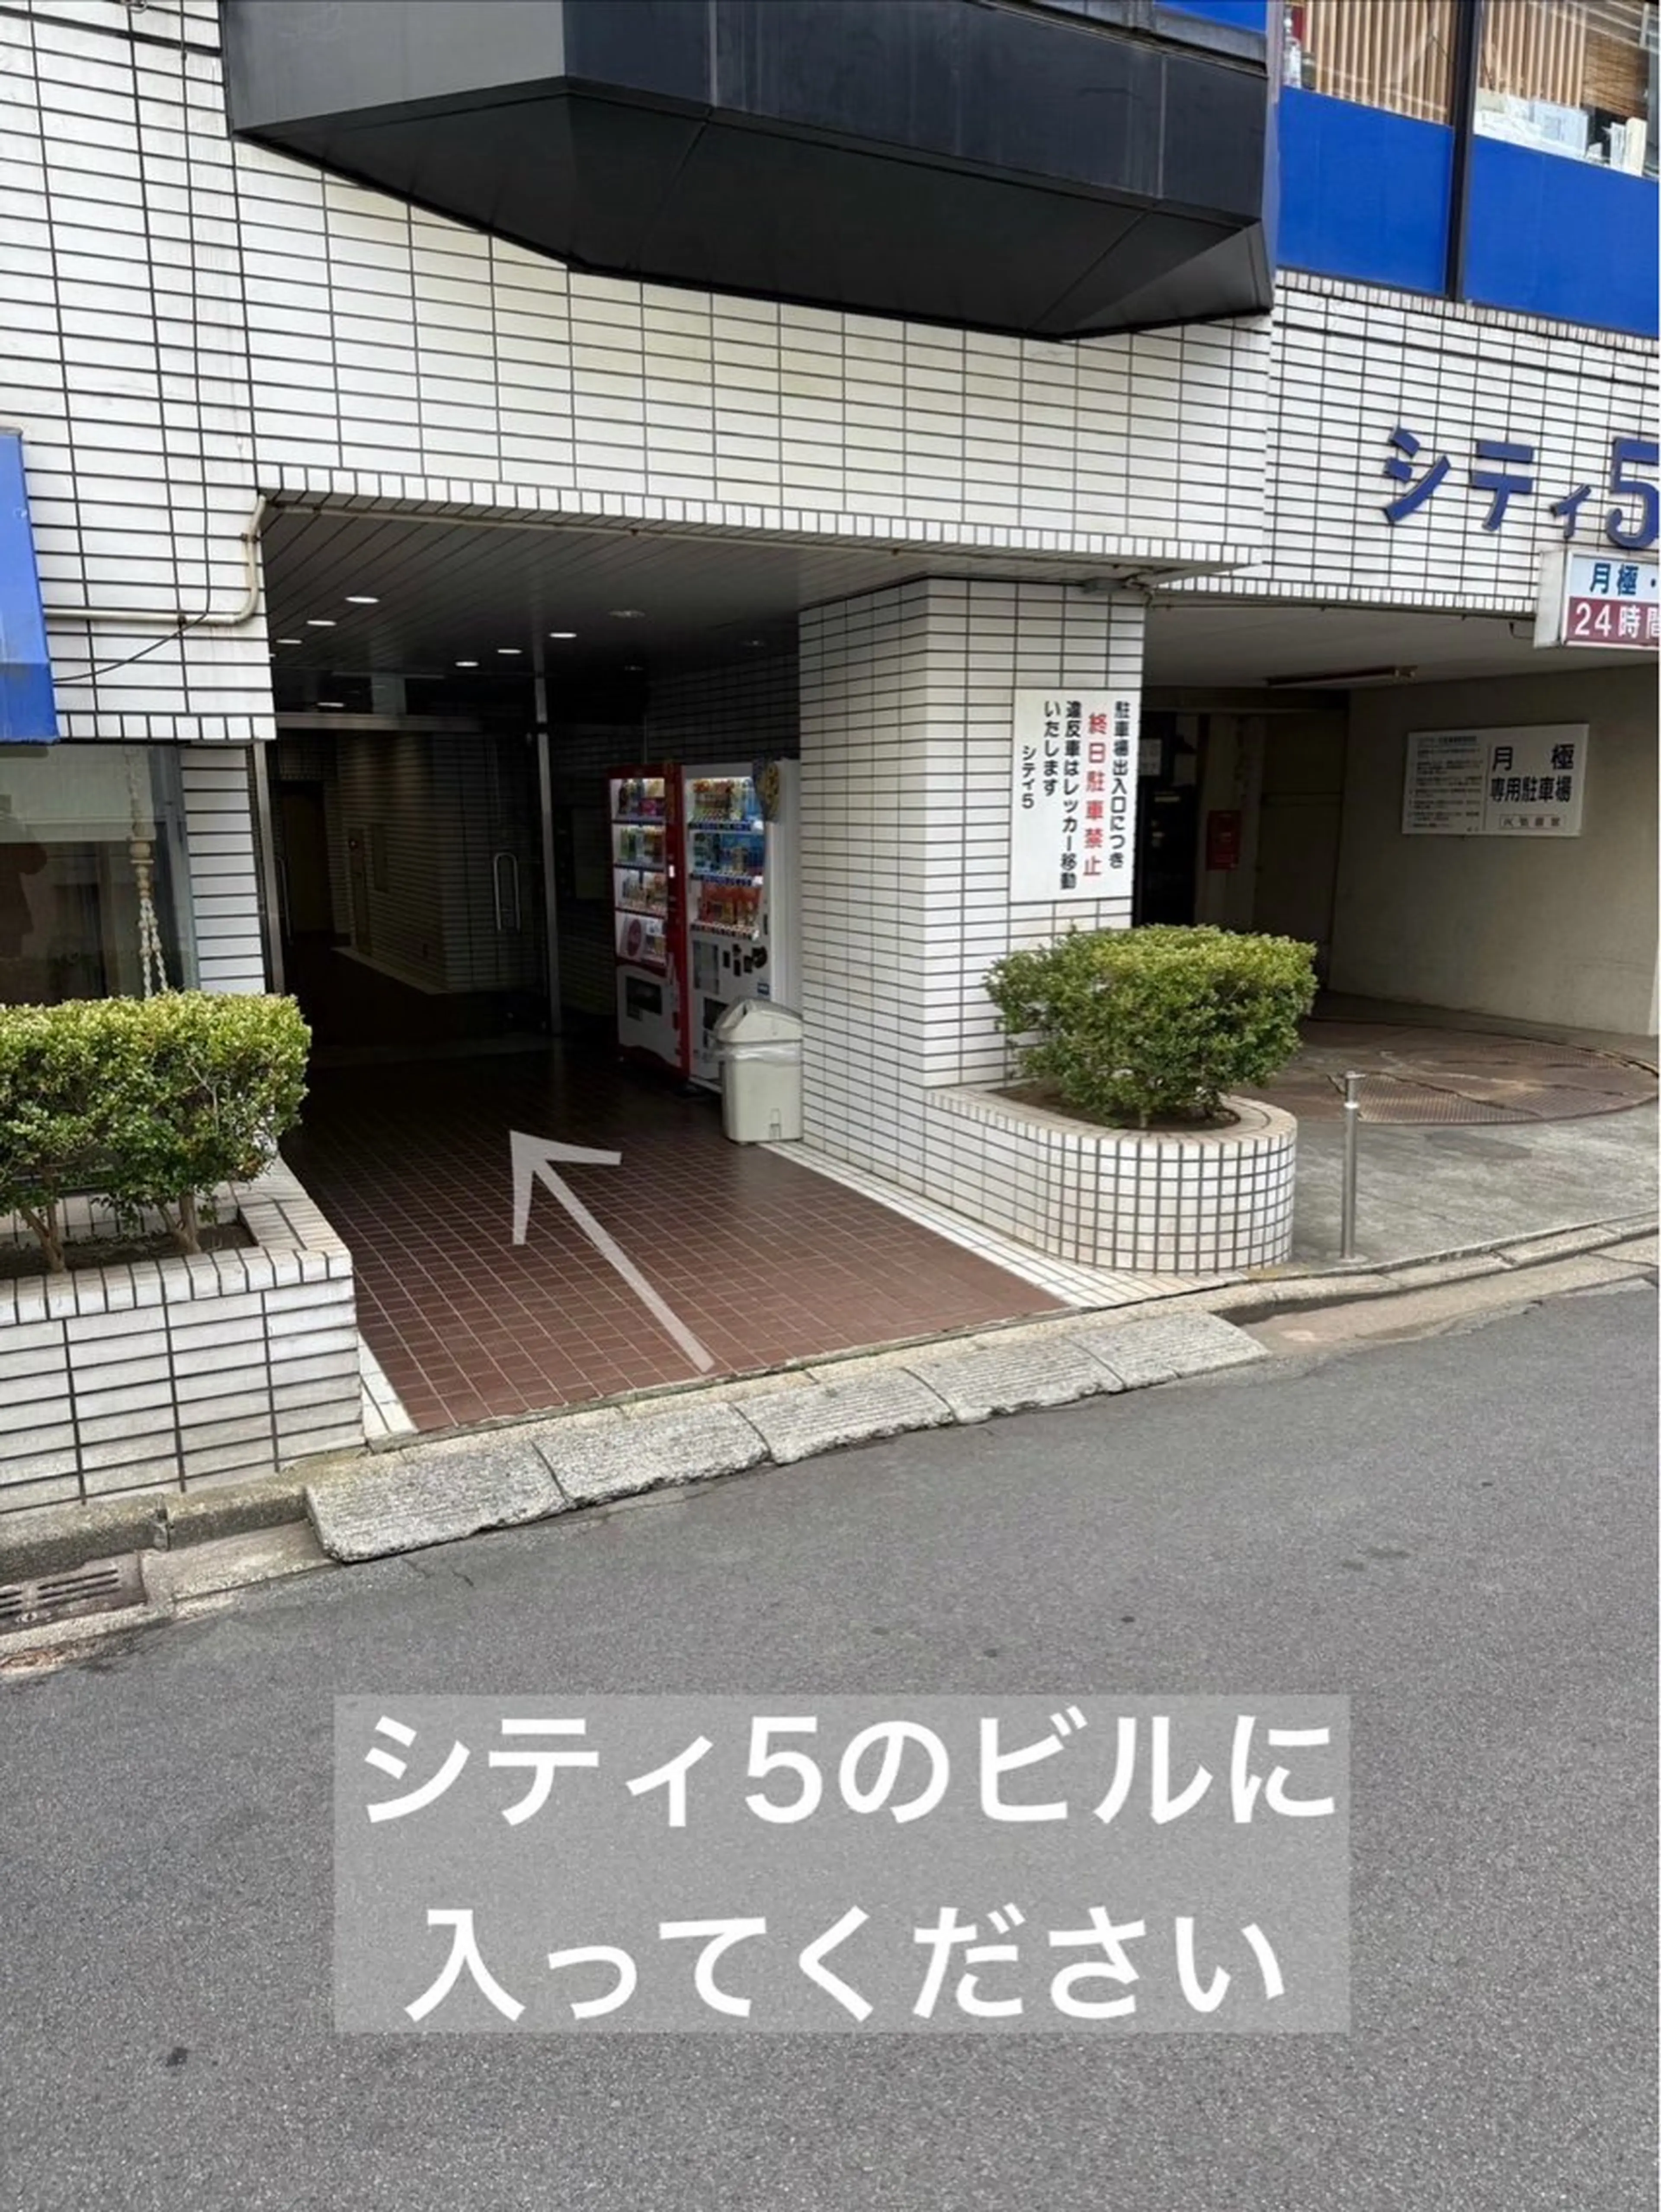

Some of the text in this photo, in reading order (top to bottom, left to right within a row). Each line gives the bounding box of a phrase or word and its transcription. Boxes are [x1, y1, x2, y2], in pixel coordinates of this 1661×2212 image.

[1384, 425, 1659, 548] シティ5
[1021, 746, 1036, 809] シティ5
[1043, 701, 1061, 797] いたします
[1060, 700, 1082, 890] 違反車はレッカー移動
[1083, 712, 1107, 876] 終日駐車禁止
[1108, 701, 1130, 869] 駐車場出入口につき
[1491, 775, 1572, 803] 専用駐車場
